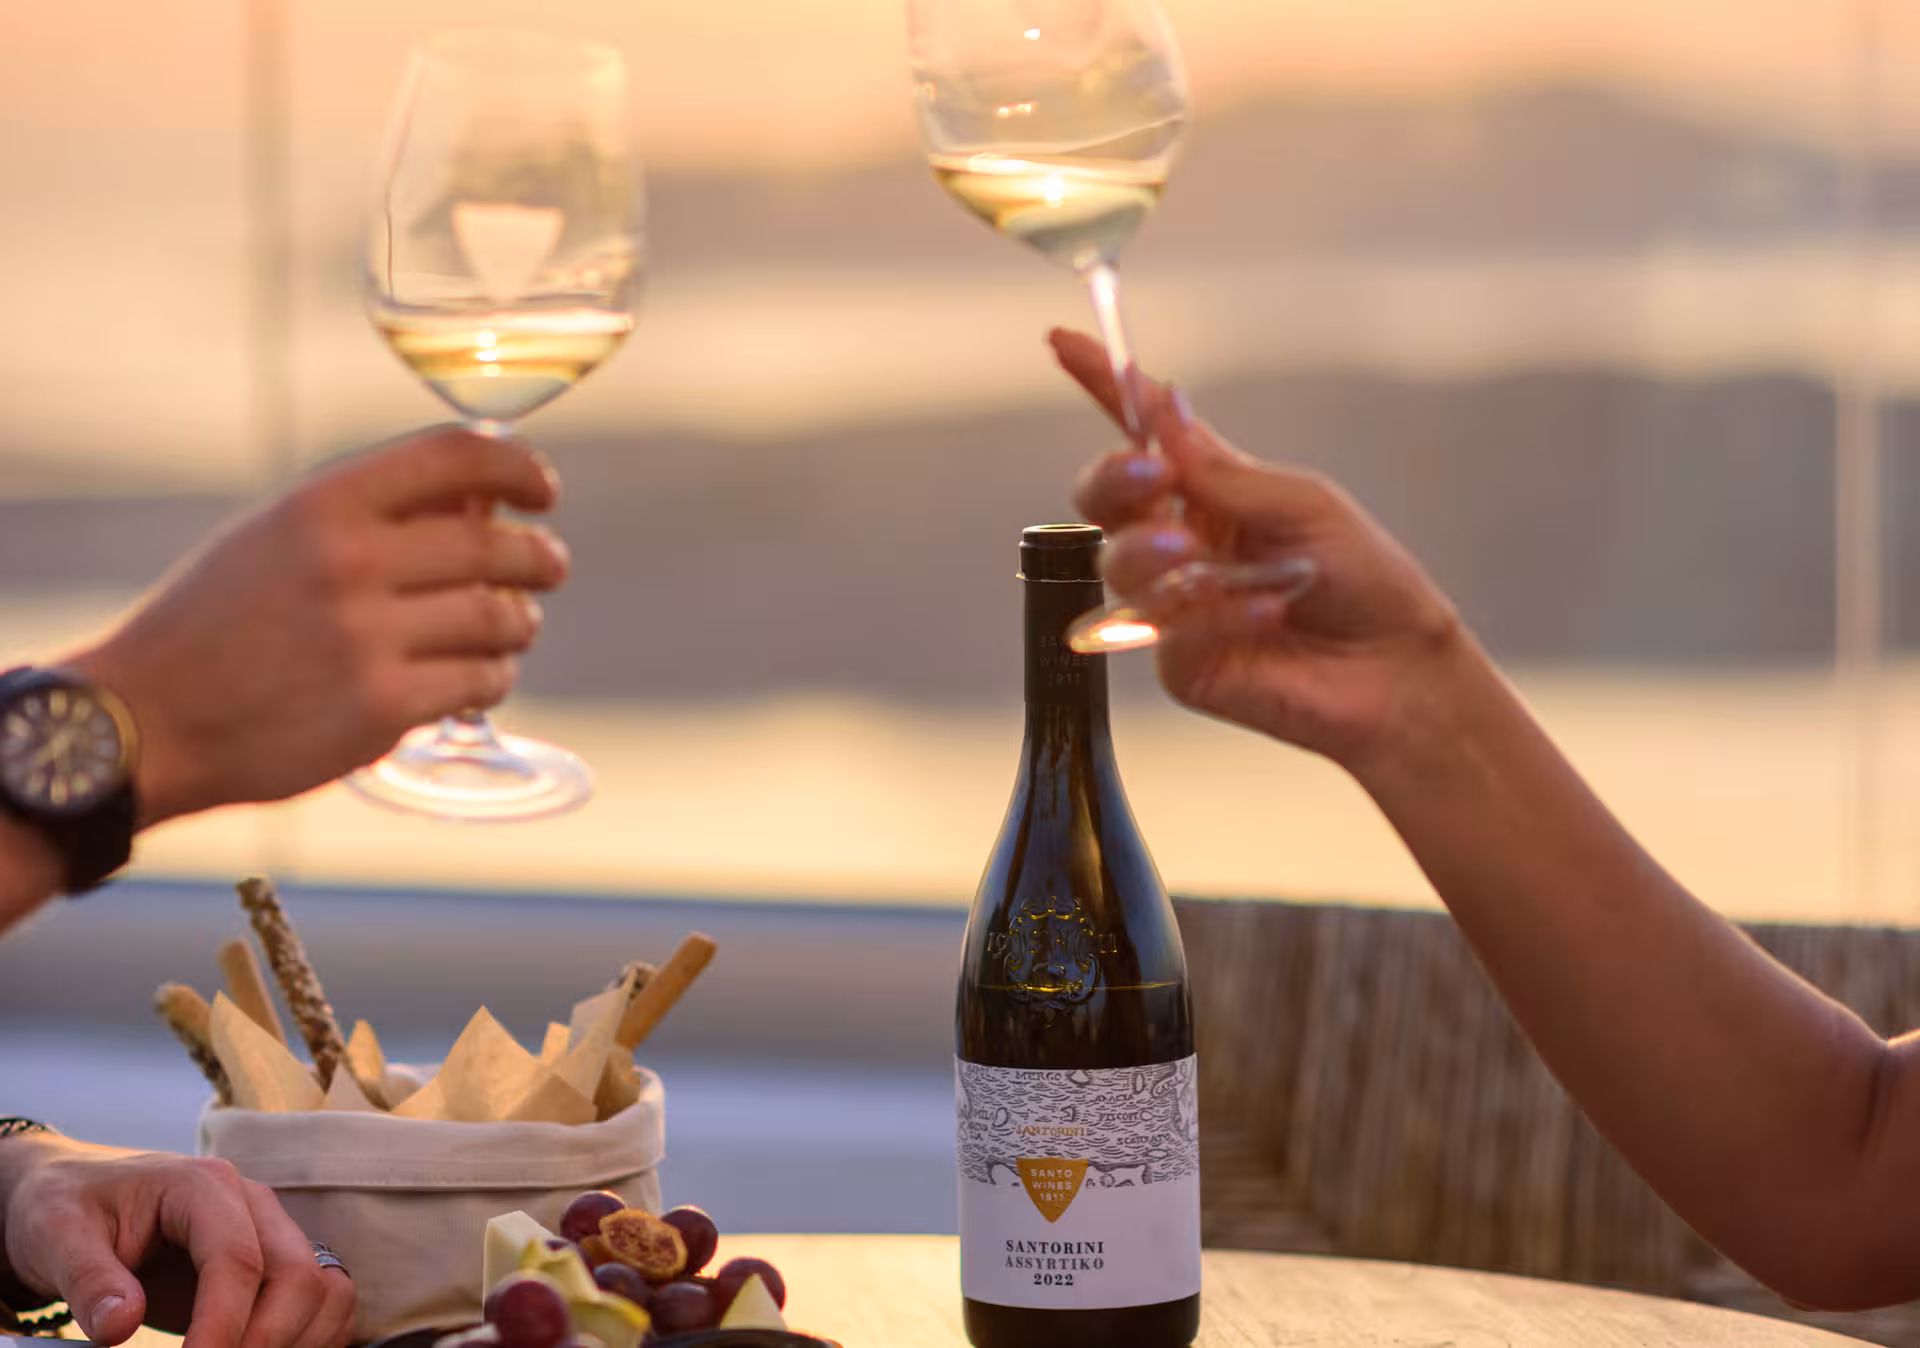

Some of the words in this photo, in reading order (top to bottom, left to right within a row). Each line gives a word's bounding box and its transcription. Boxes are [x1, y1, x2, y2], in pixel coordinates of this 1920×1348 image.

[1016, 1125, 1086, 1137] SANTORINI
[1030, 1168, 1073, 1178] SANTO
[1032, 1180, 1073, 1191] WINES
[1005, 1239, 1105, 1255] SANTORINI
[1005, 1256, 1105, 1271] ASSYRTIKO
[1033, 1273, 1074, 1287] 2022
